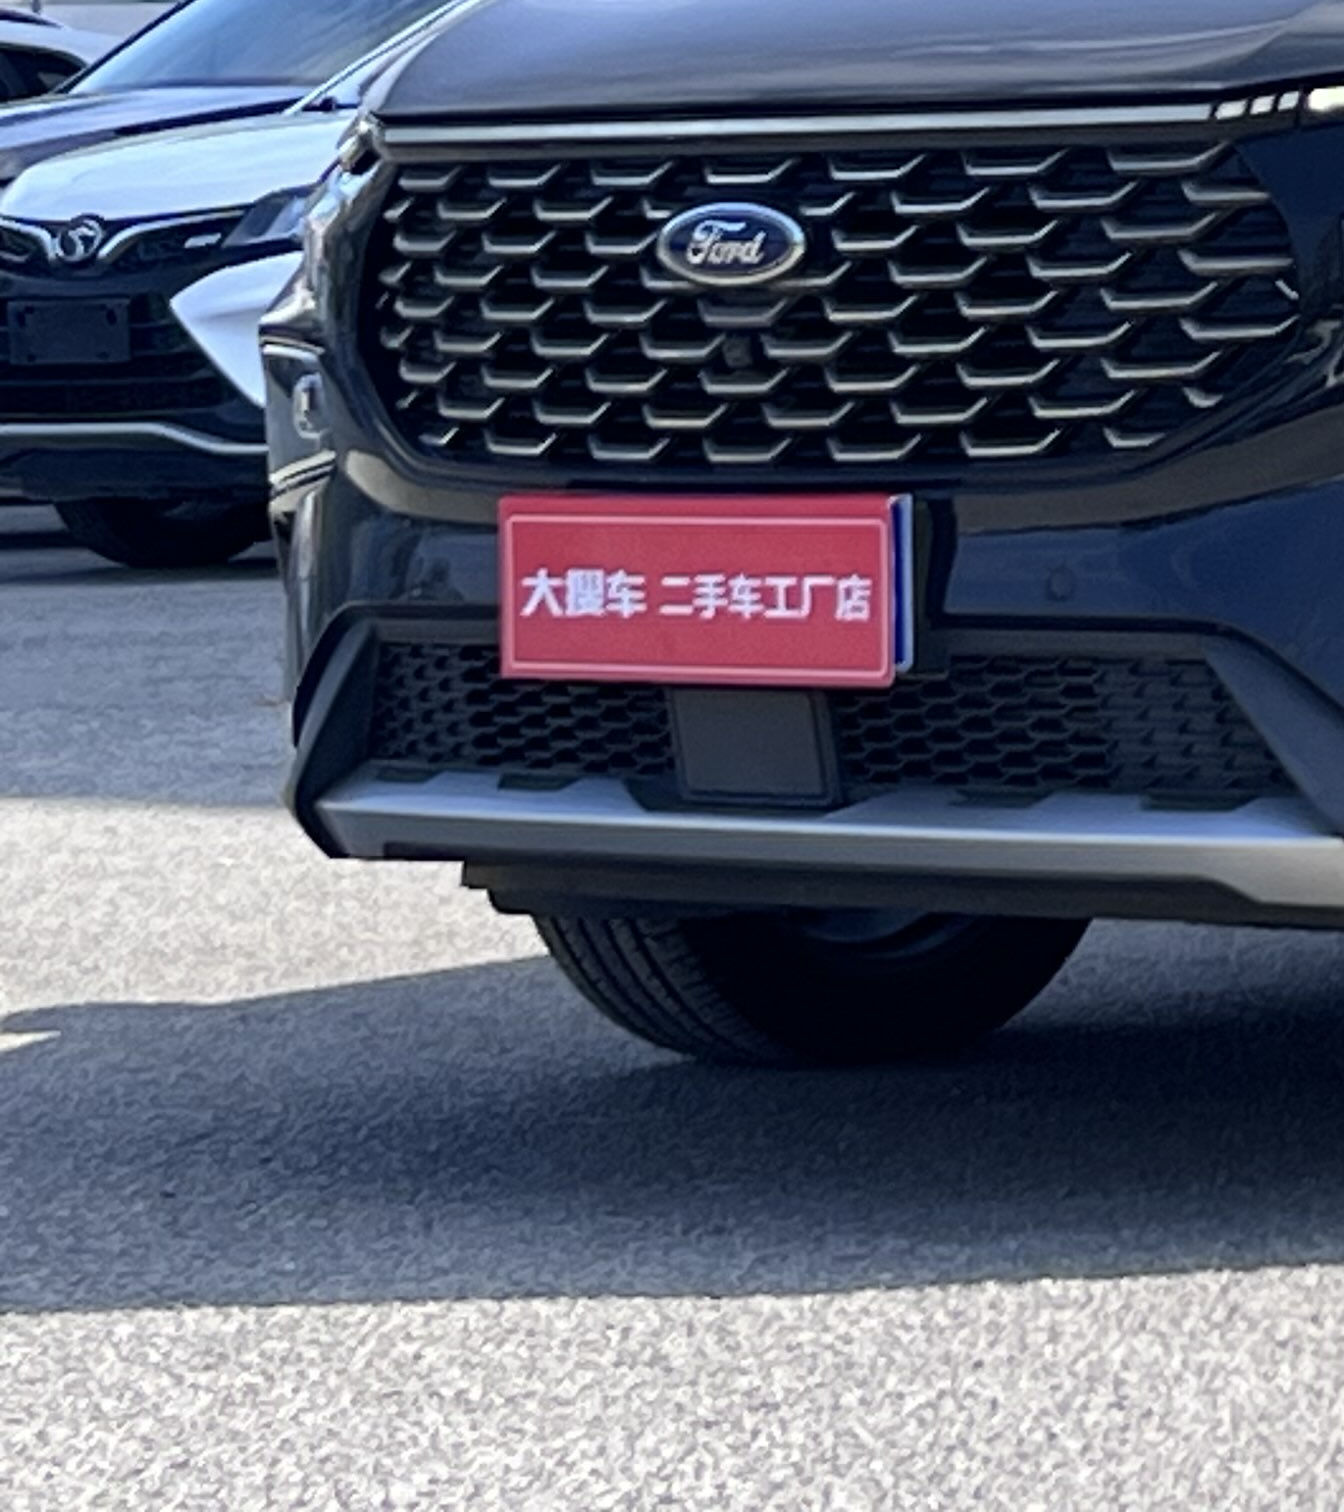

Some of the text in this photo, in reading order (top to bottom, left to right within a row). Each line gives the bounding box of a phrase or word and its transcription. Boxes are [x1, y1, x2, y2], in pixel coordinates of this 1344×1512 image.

[686, 220, 767, 265] Ford
[659, 573, 873, 622] 二手车工厂店
